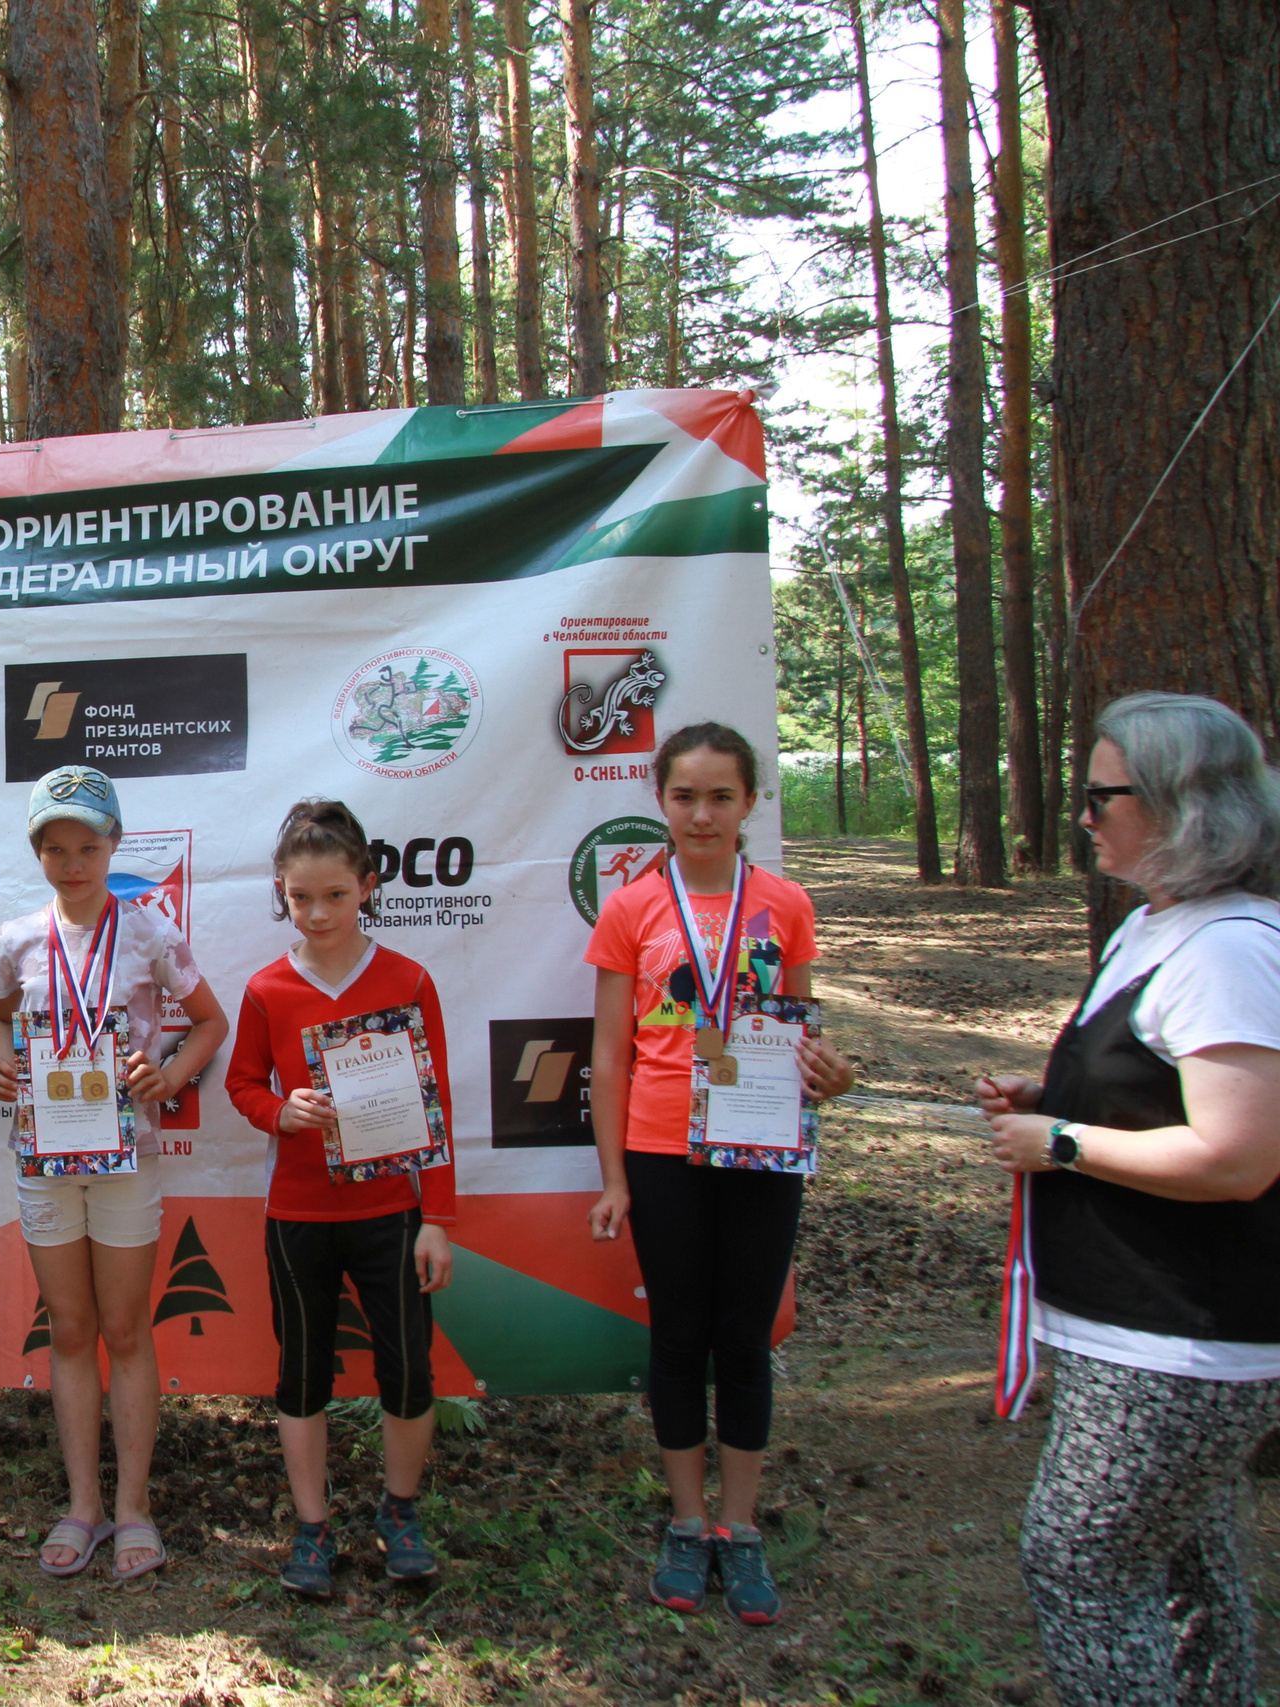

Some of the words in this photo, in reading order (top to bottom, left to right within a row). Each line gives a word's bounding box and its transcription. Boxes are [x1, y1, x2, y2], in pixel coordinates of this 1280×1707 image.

[282, 535, 429, 576] ОКРУГ
[560, 616, 650, 630] Ориентирование
[543, 633, 550, 643] в
[552, 629, 620, 642] Челябинской
[622, 629, 668, 641] области
[334, 672, 362, 720] ФЕДЕРАЦИЯ
[360, 648, 424, 674] СПОРТИВНОГО
[424, 649, 479, 698] ОРИЕНТИРОВАНИЯ
[84, 703, 136, 719] ФОНД
[84, 719, 232, 739] ПРЕЗИДЕНТСКИХ
[85, 743, 162, 759] ГРАНТОВ
[356, 758, 413, 779] КУРГАНСКОЙ
[414, 751, 458, 776] ОБЛАСТИ
[574, 764, 649, 782] O-CHEL.RU
[575, 834, 602, 882] ФЕДЕРАЦИЯ
[605, 822, 669, 841] СПОРТИВНОГО
[385, 894, 492, 913] спортивного
[576, 889, 599, 921] БЛАСТИ
[436, 909, 484, 929] Югры
[730, 1032, 793, 1047] РАМОТА
[335, 1046, 403, 1071] ГРАМОТА
